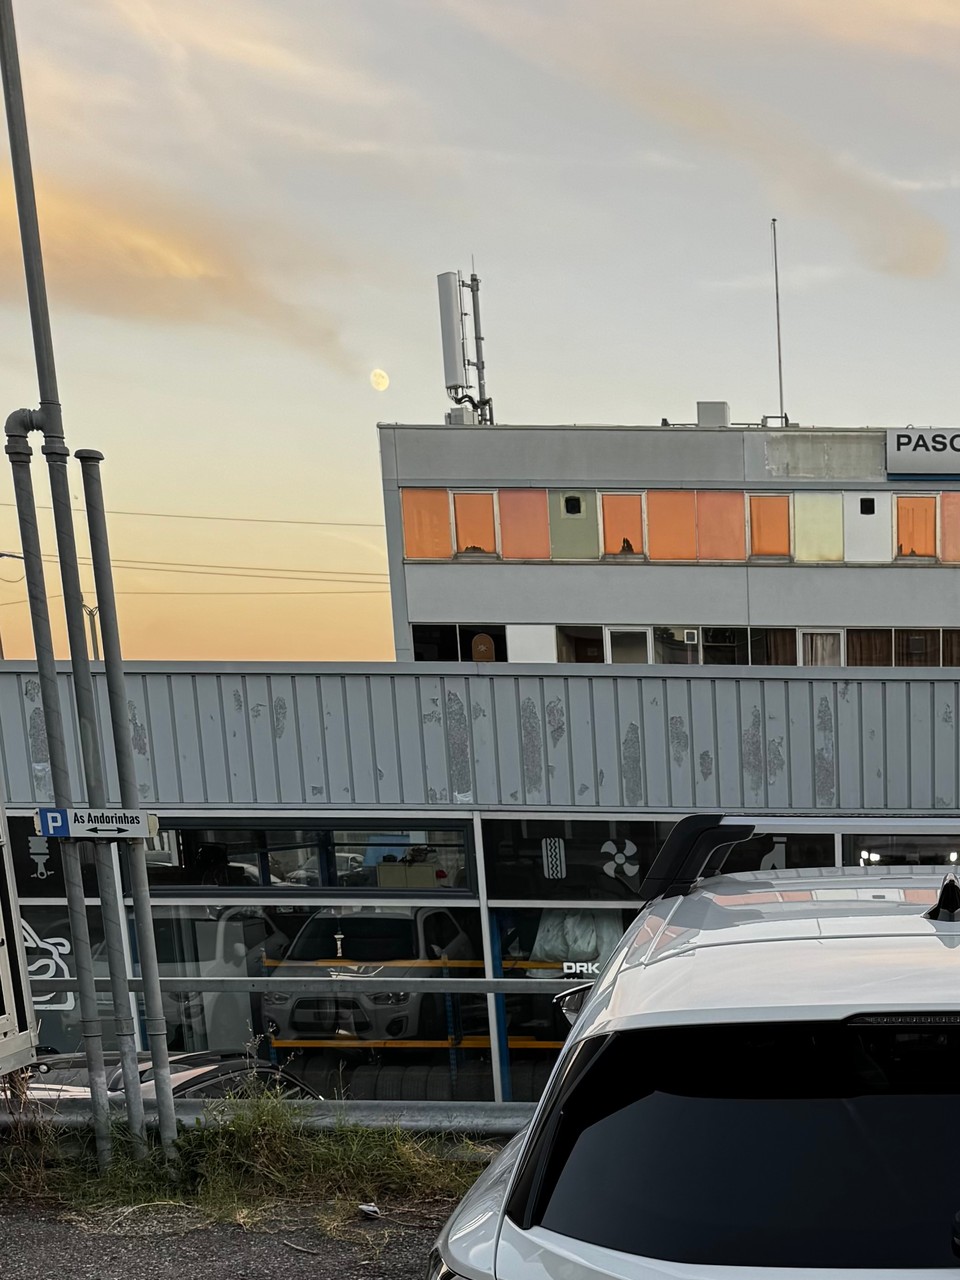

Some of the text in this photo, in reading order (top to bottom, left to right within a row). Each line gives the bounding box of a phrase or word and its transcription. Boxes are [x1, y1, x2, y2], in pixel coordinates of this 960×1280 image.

[47, 812, 141, 834] P As Andorinhas
[562, 962, 600, 974] DRK
